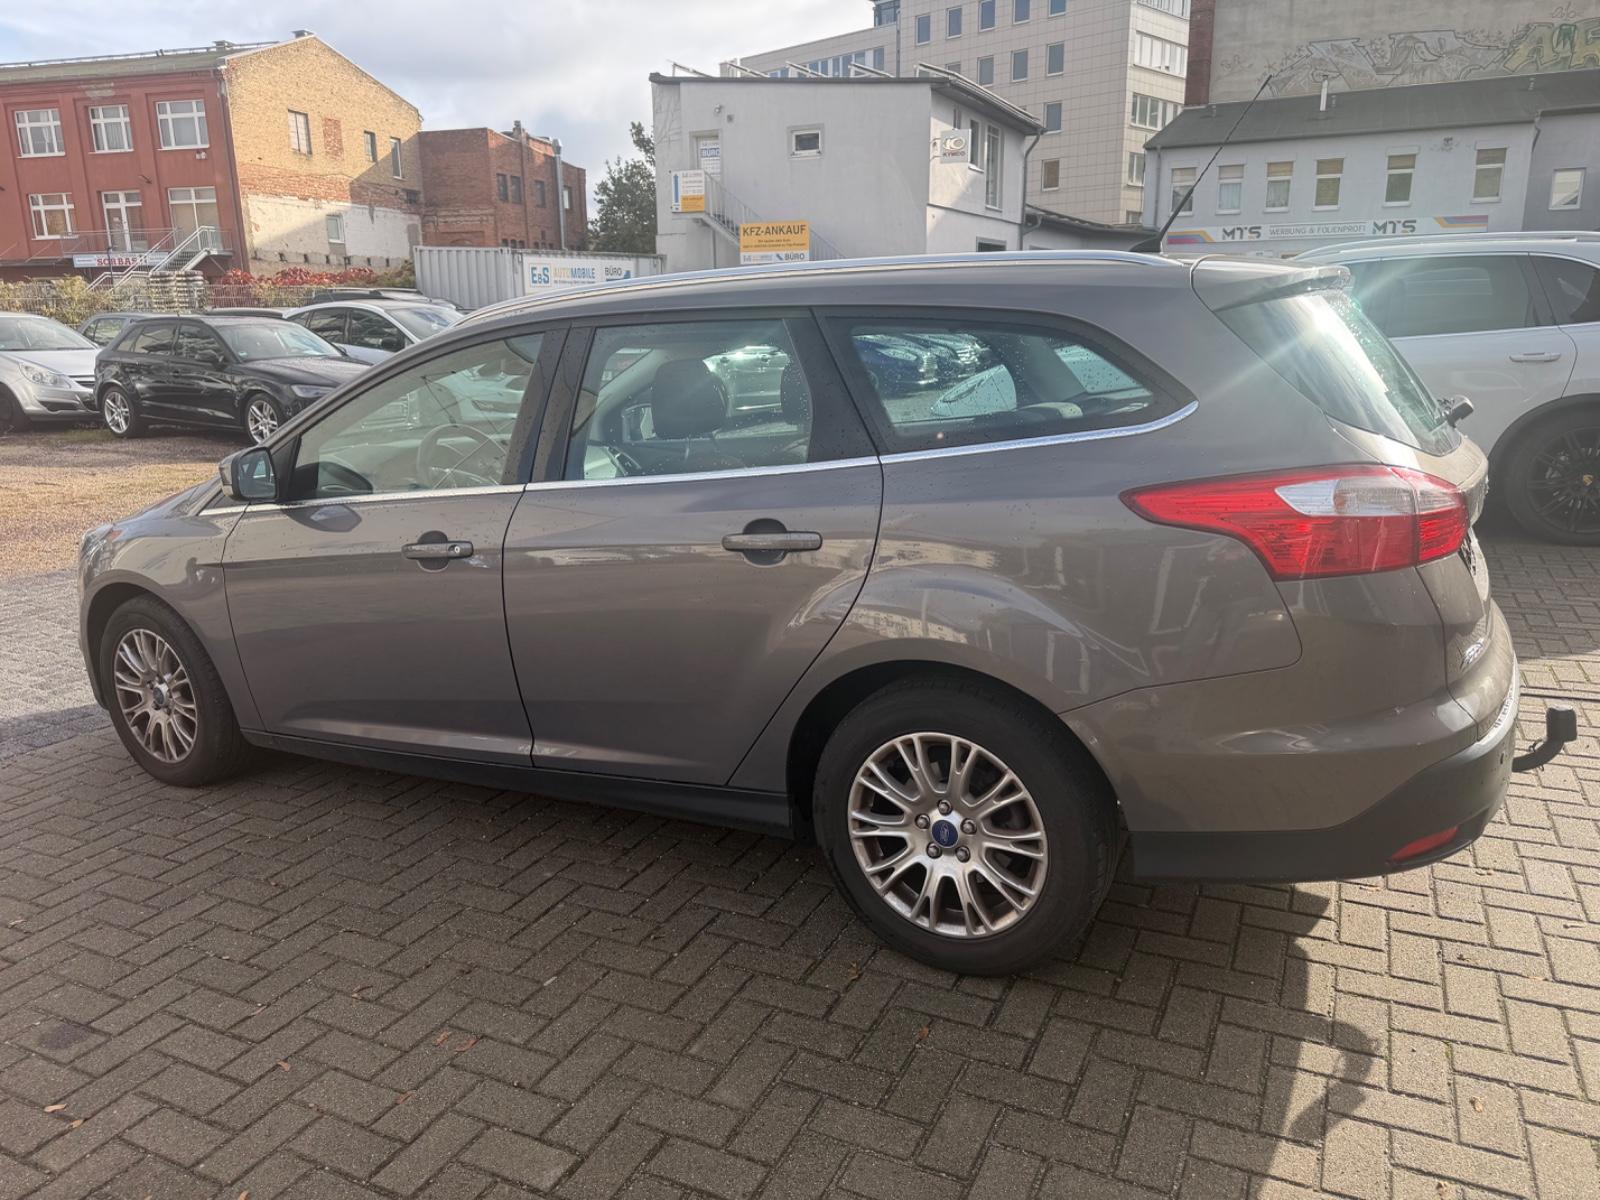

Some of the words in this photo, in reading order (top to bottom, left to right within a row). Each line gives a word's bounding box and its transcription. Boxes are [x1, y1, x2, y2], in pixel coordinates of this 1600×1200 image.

[742, 224, 806, 237] KFZ-ANKAUF
[1222, 226, 1261, 240] MTS
[1372, 219, 1417, 234] MTS
[784, 252, 805, 261] BÜRO
[553, 267, 596, 279] AUTOMOBILE
[604, 266, 622, 276] BÜRO
